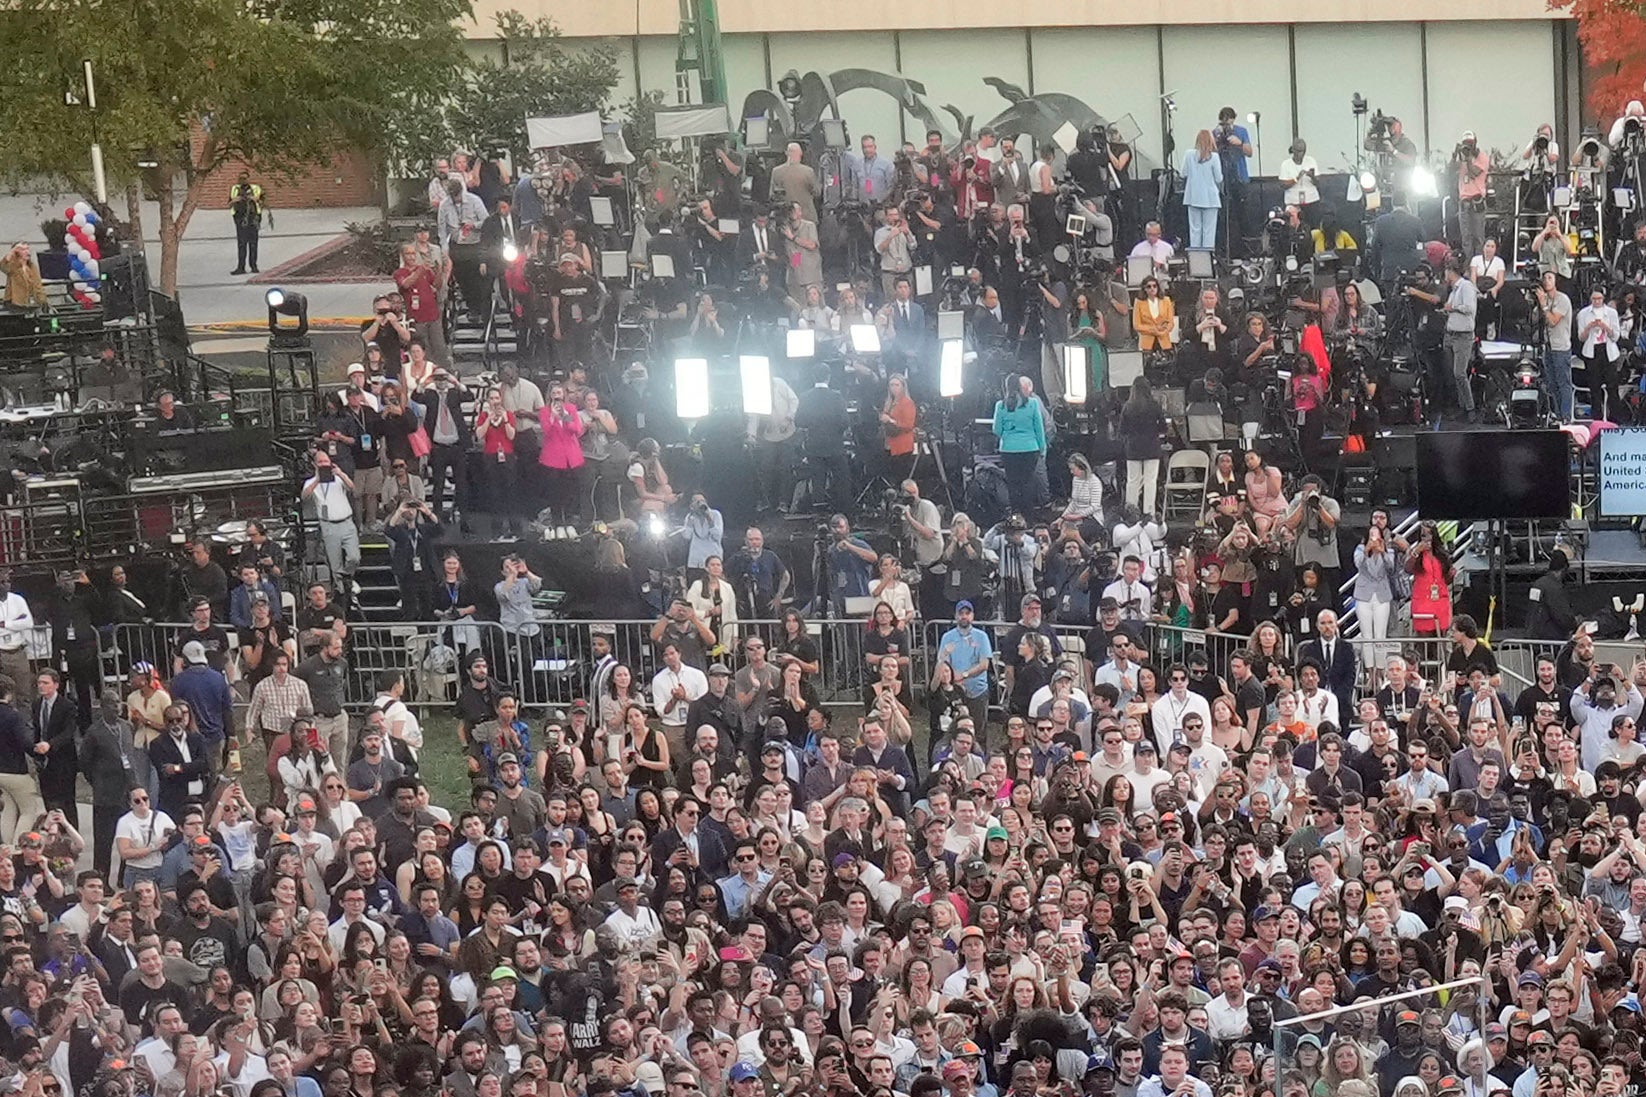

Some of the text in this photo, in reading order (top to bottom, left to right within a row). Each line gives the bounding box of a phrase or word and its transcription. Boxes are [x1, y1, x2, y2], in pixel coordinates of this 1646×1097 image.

[1603, 452, 1627, 462] And
[1603, 466, 1641, 476] United
[570, 1021, 600, 1038] ARRI
[572, 1037, 602, 1049] WALZ
